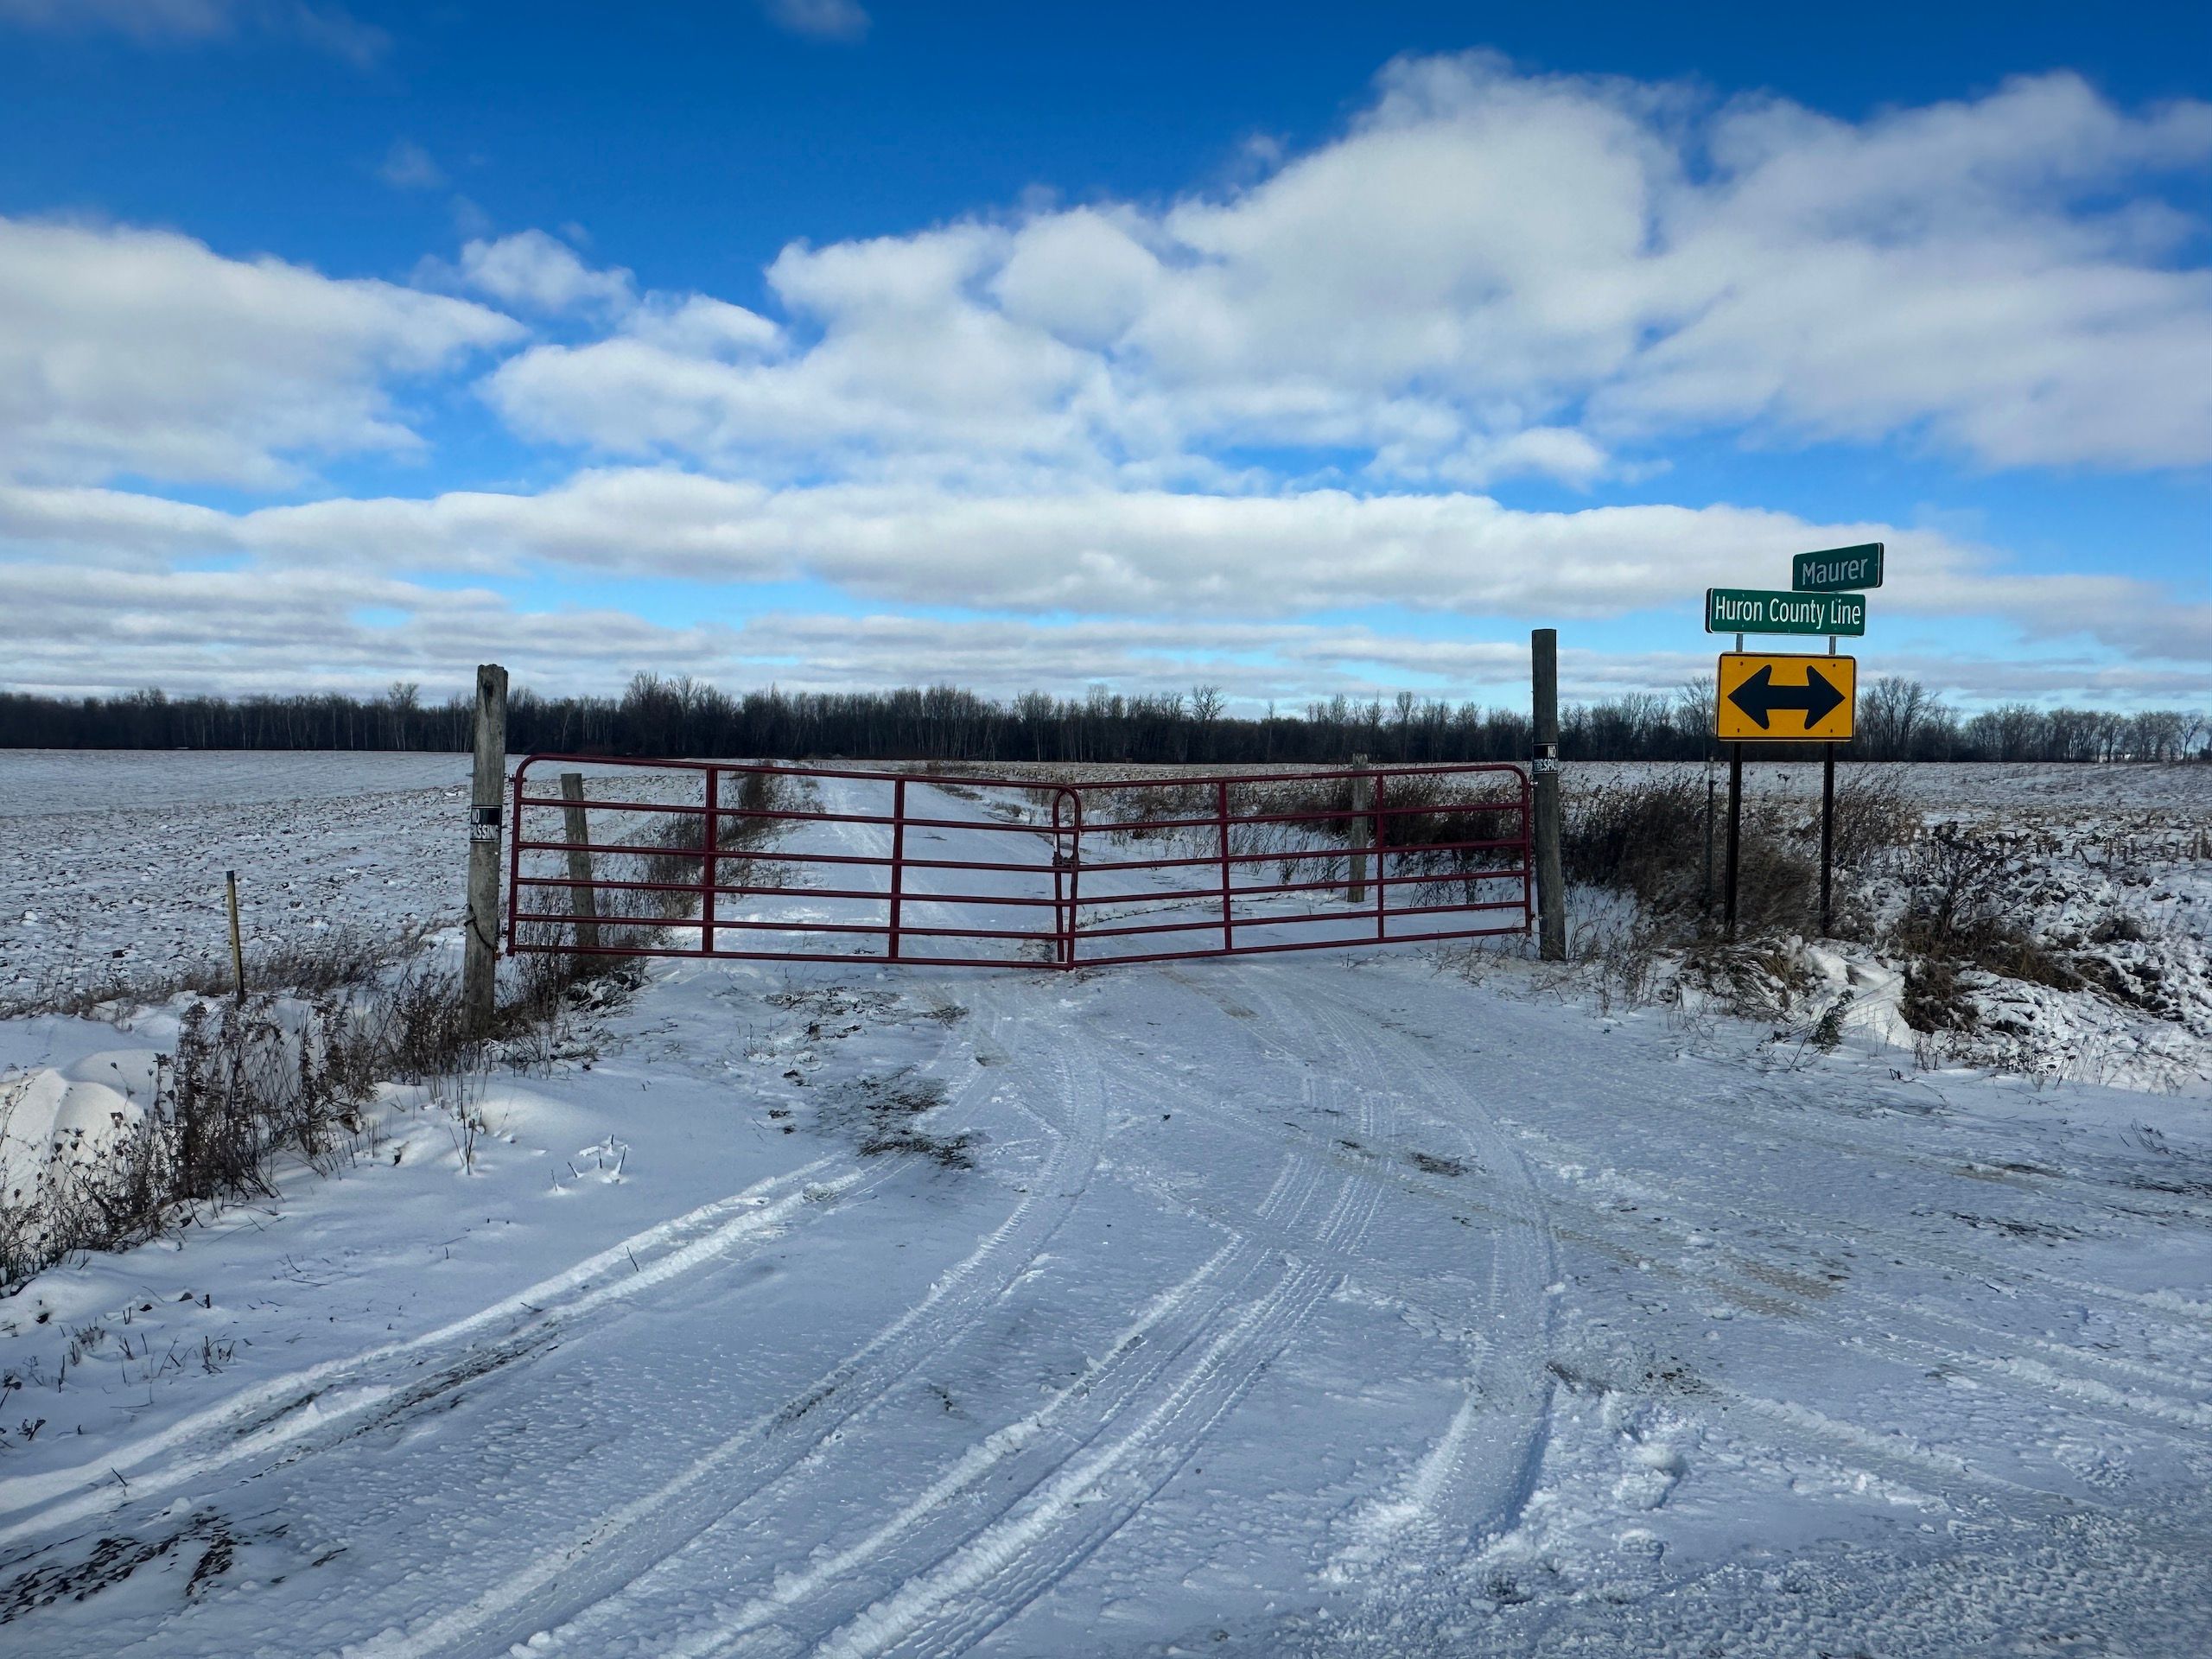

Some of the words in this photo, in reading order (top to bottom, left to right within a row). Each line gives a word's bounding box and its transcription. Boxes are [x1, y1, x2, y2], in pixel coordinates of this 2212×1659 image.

[1802, 557, 1869, 586] Maurer
[1715, 595, 1763, 621] Huron
[1770, 597, 1825, 629] County
[1830, 599, 1861, 625] Line
